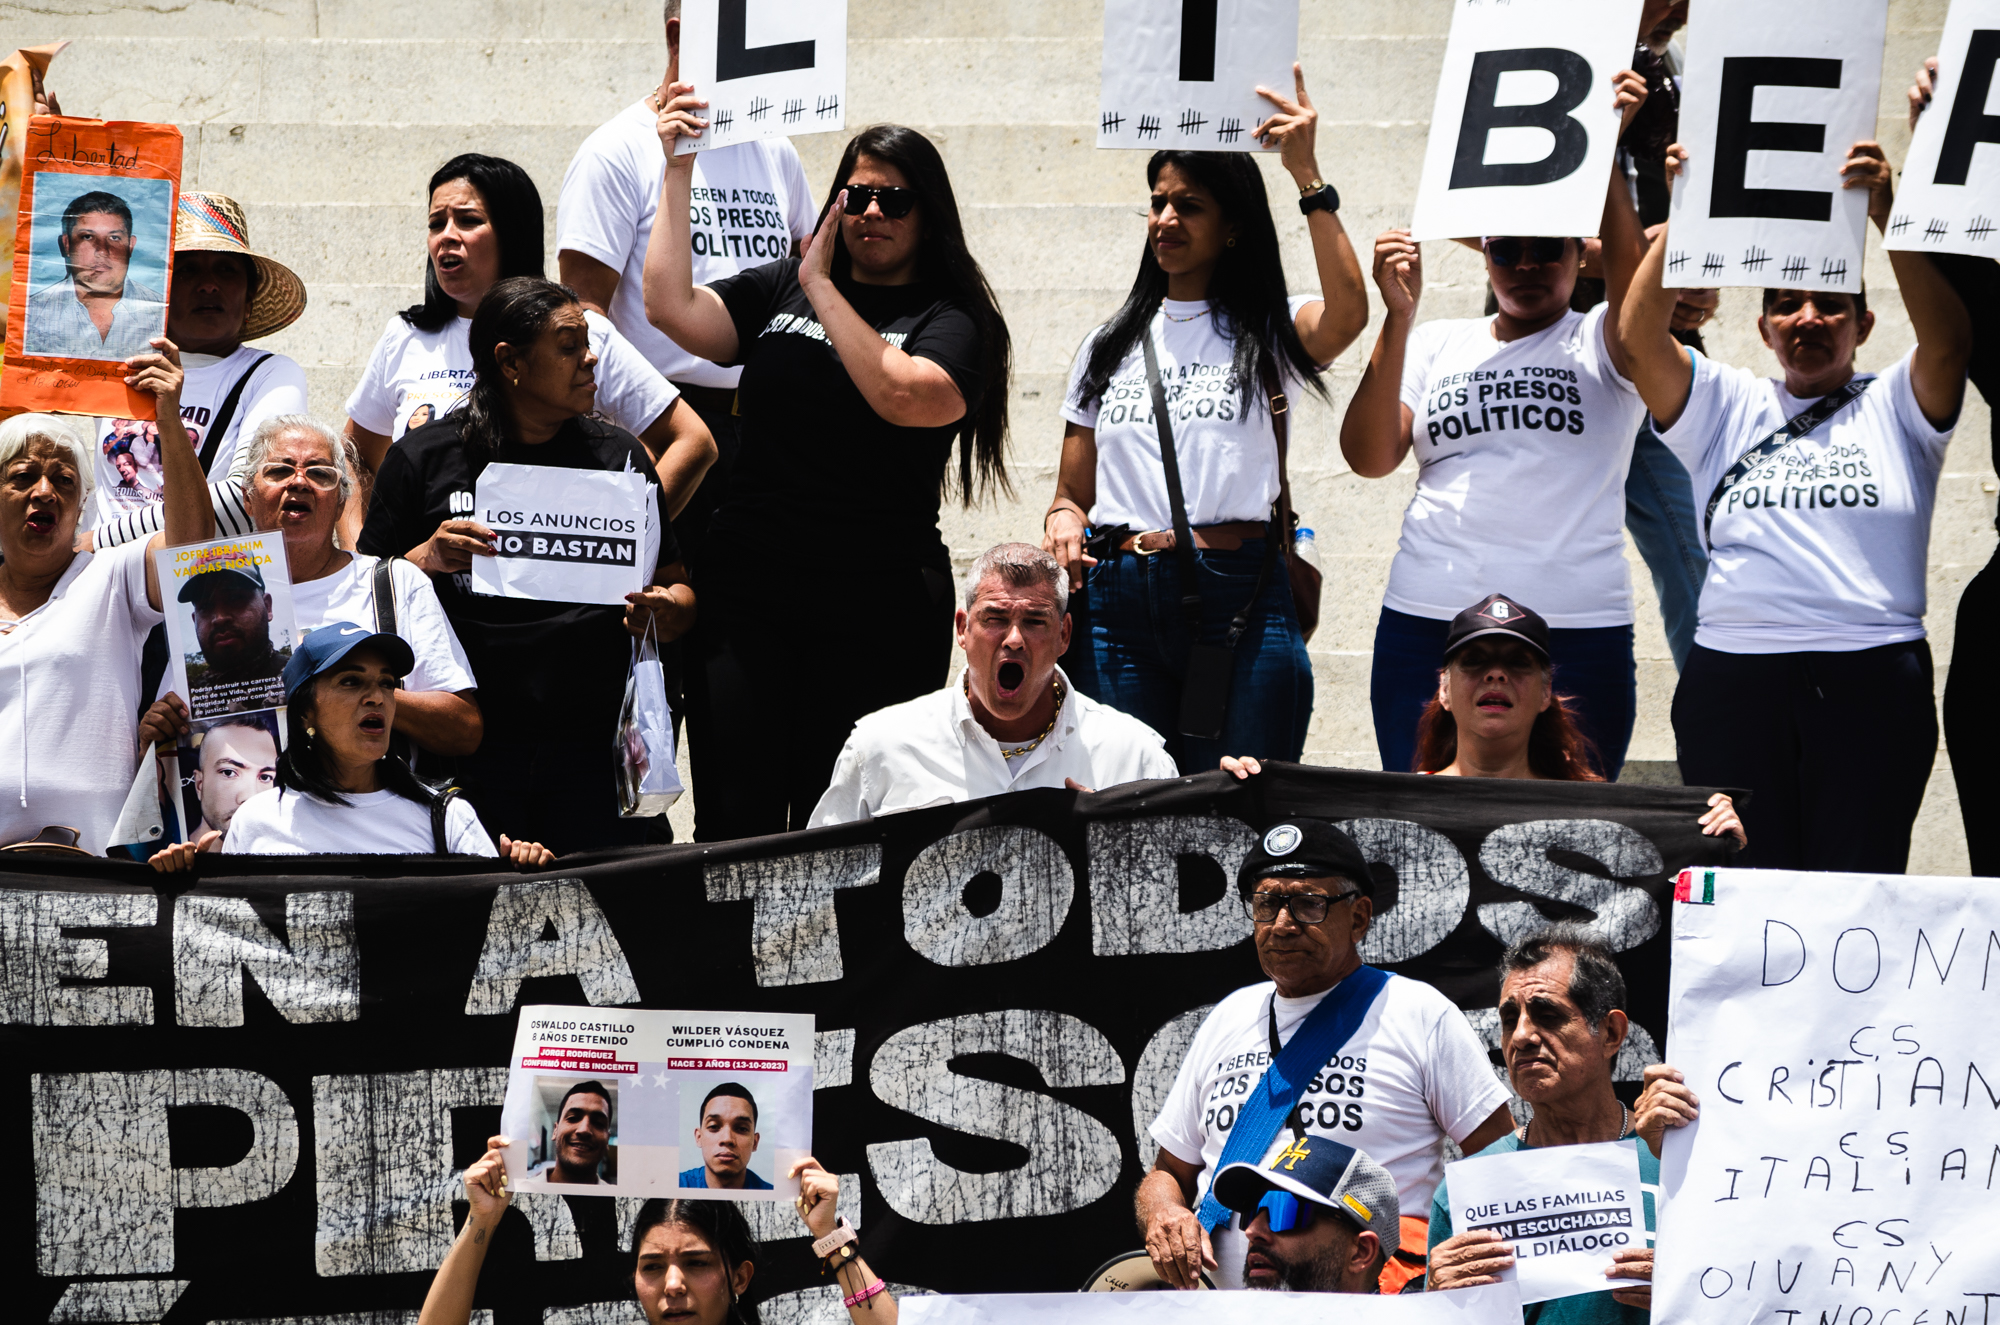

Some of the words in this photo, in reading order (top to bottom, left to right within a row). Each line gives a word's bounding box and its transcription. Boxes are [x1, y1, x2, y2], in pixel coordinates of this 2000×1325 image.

[1448, 47, 1594, 190] B
[30, 120, 142, 169] Libertad
[1709, 56, 1843, 221] E
[691, 187, 727, 203] EREN
[732, 188, 741, 203] A
[690, 206, 711, 226] OS
[717, 208, 785, 230] PRESOS
[691, 229, 788, 259] OLÍTICOS
[419, 369, 475, 381] LIBERTA
[1178, 365, 1187, 379] A
[1191, 362, 1232, 377] TODO
[1430, 370, 1497, 395] LIBEREN
[1503, 369, 1515, 379] A
[1520, 366, 1578, 384] TODOS
[1166, 379, 1236, 402] RESOS
[1427, 387, 1469, 417] LOS
[1479, 380, 1582, 406] PRESOS
[1099, 397, 1235, 432] POLICOS
[1428, 402, 1585, 447] POLÍTICOS
[1744, 465, 1777, 483] OS
[1785, 460, 1872, 482] PRESOS
[449, 491, 473, 513] NO
[1728, 482, 1879, 514] POLÍTICOS
[486, 510, 524, 525] LOS
[530, 513, 635, 533] ANUNCIOS
[175, 548, 209, 562] JOFRE
[212, 540, 263, 557] IBRAHIM
[488, 535, 523, 552] NO
[532, 537, 632, 561] BASTAN
[173, 561, 222, 578] VARGAS
[225, 554, 272, 570] NOVOA
[1492, 601, 1509, 618] G
[213, 682, 240, 690] destruir
[250, 677, 276, 685] carrera
[247, 686, 263, 694] pero
[231, 695, 249, 703] valor
[204, 706, 229, 716] justicia
[465, 878, 642, 1015] A
[703, 815, 1665, 987] TODOS
[530, 1020, 577, 1030] OSWALDO
[579, 1022, 635, 1033] CASTILLO
[672, 1026, 721, 1035] WILDER
[725, 1025, 785, 1037] VÁSQUEZ
[532, 1032, 537, 1041] 8
[539, 1031, 568, 1042] AÑOS
[570, 1034, 628, 1046] DETENIDO
[666, 1037, 725, 1048] CUMPLIÓ
[728, 1039, 790, 1050] CONDENA
[522, 1058, 560, 1068] CONFIRMÓ
[560, 1061, 578, 1070] QUE
[592, 1062, 636, 1071] INOCENTE
[540, 1049, 565, 1057] JORGE
[566, 1049, 613, 1060] RODRÍGUEZ
[670, 1060, 695, 1068] HACE
[705, 1059, 730, 1068] AÑOS
[732, 1060, 786, 1071] (13-10-2023)
[1210, 1073, 1249, 1102] LOS
[1465, 1203, 1500, 1222] QUE
[1504, 1199, 1537, 1214] LAS
[1542, 1189, 1625, 1209] FAMILIAS
[1517, 1211, 1631, 1237] ESCUCHADAS
[1533, 1232, 1630, 1257] DIÁLOGO
[1104, 1275, 1129, 1290] CALLE
